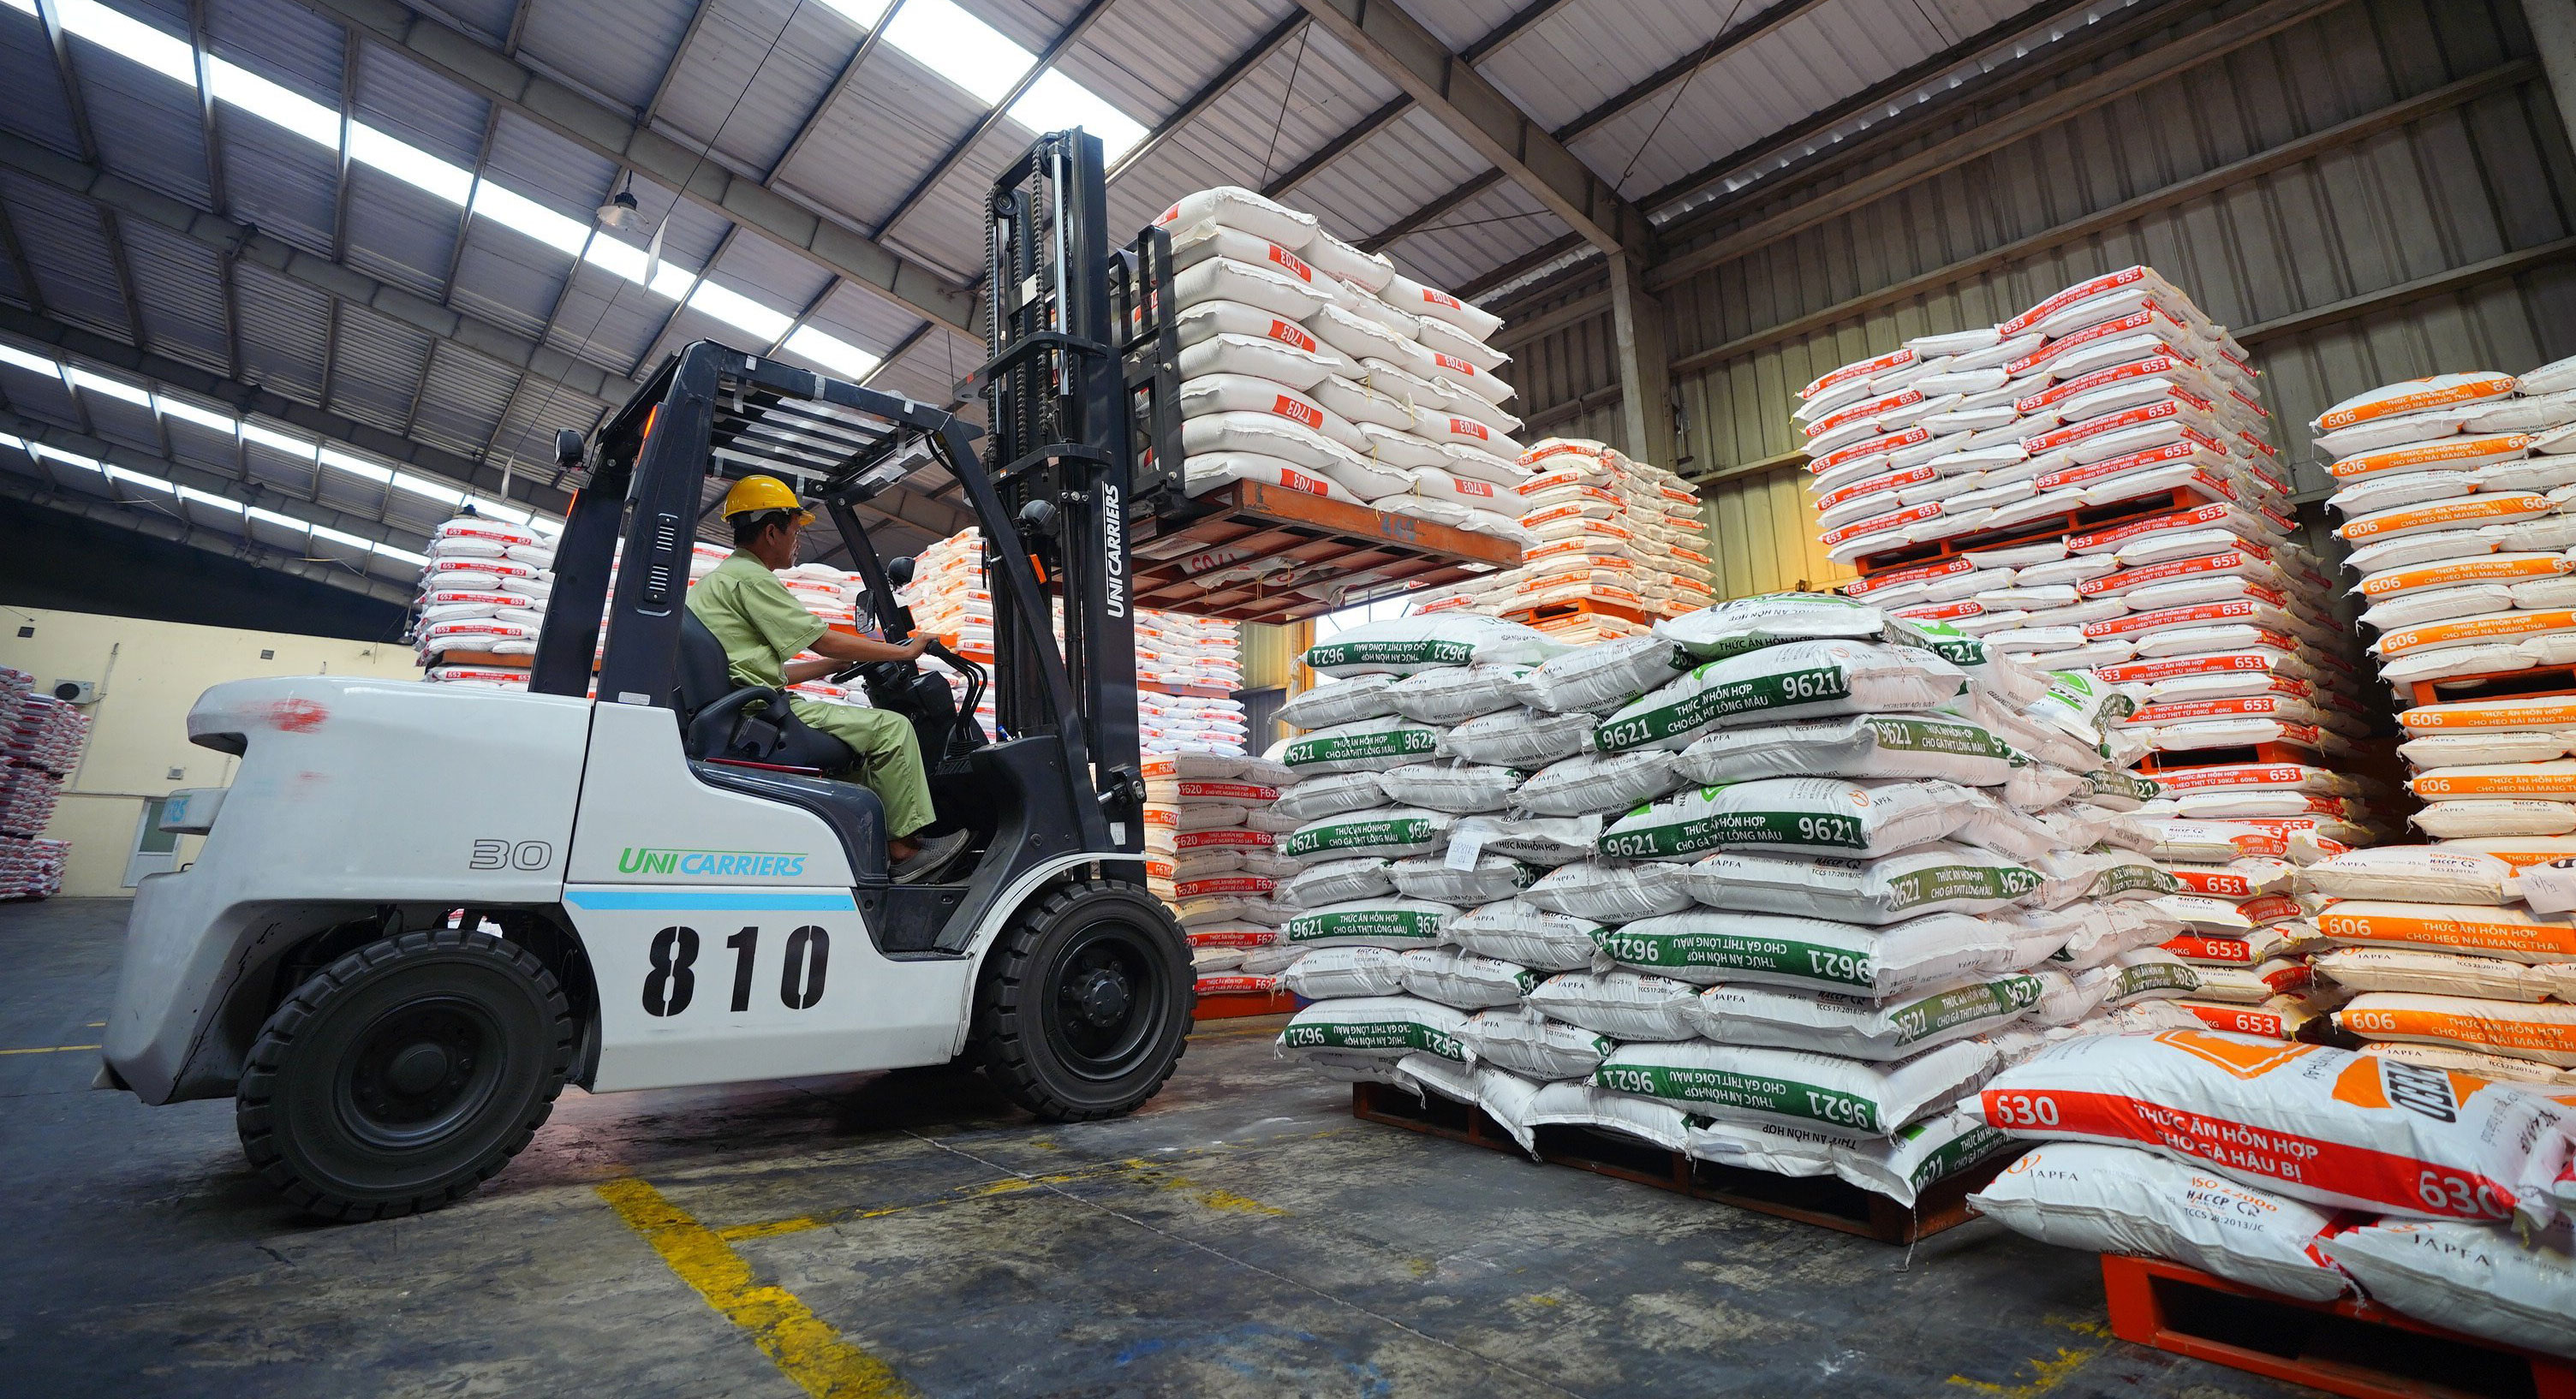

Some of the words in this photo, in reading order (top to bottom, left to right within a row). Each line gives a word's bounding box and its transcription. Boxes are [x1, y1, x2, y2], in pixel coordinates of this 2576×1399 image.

[1280, 250, 1302, 275] T703
[2116, 269, 2139, 284] 653
[1432, 291, 1452, 307] T703
[2003, 318, 2025, 334] 653
[2126, 313, 2150, 327] 653
[1445, 356, 1465, 372] T703
[1892, 352, 1910, 364] 653
[2142, 358, 2167, 372] 653
[2020, 396, 2043, 410] 653
[2148, 403, 2172, 418] 653
[1286, 401, 1311, 423] T703
[2328, 410, 2357, 426] 606
[1459, 420, 1480, 437] T703
[2164, 445, 2190, 458] 653
[2338, 460, 2367, 474] 606
[1463, 481, 1484, 495] T703
[1918, 504, 1938, 517] 653
[2347, 521, 2379, 537] 606
[517, 537, 532, 545] 652
[2070, 535, 2093, 549] 653
[1849, 583, 1869, 594] 653
[2369, 577, 2401, 593] 606
[1959, 602, 1978, 614] 653
[2222, 603, 2250, 615] 653
[2087, 623, 2112, 635] 653
[2387, 633, 2418, 650] 606
[1313, 647, 1345, 664] 9621
[1434, 643, 1467, 661] 9621
[2234, 658, 2263, 669] 653
[1732, 683, 1753, 697] HỢP
[1783, 670, 1841, 700] 9621
[2243, 699, 2269, 711] 653
[1667, 719, 1688, 733] CHO
[1716, 698, 1744, 716] LÔNG
[1745, 694, 1769, 710] MÀU
[2409, 714, 2443, 726] 606
[1603, 718, 1651, 749] 9621
[1182, 784, 1202, 794] F620
[2420, 779, 2451, 792] 606
[1684, 820, 1708, 835] THỨC
[1744, 816, 1766, 828] HỢP
[1798, 817, 1858, 845] 9621
[1607, 833, 1659, 857] 9621
[1676, 839, 1696, 852] CHO
[1727, 830, 1756, 842] LÔNG
[1757, 830, 1782, 842] MÀU
[469, 839, 552, 871] 30
[2207, 877, 2242, 893] 653
[1340, 914, 1357, 923] THỨC
[1385, 914, 1398, 924] HỢP
[2329, 917, 2371, 936] 606
[1292, 918, 1323, 938] 9621
[1357, 926, 1372, 934] THỊT
[1373, 925, 1392, 933] LÔNG
[1393, 925, 1407, 934] MÀU
[2422, 921, 2457, 933] THỨC
[2459, 923, 2478, 934] ĂN
[2479, 923, 2509, 938] HỖN
[2511, 927, 2538, 942] HỢP
[1609, 938, 1659, 962] 9621
[1673, 938, 1696, 951] MÀU
[1696, 937, 1722, 952] LÔNG
[1722, 938, 1745, 951] THỊT
[1746, 940, 1761, 953] GÀ
[1765, 943, 1787, 954] CHO
[2206, 941, 2243, 957] 653
[2406, 932, 2431, 942] CHO
[2434, 934, 2460, 945] HEO
[2462, 934, 2485, 947] NÁI
[2487, 938, 2525, 950] MANG
[2528, 940, 2560, 952] THAI
[1687, 950, 1706, 963] HỢP
[1707, 951, 1728, 965] HỖN
[1730, 953, 1745, 966] ĂN
[1747, 955, 1777, 968] THỨC
[642, 926, 830, 1016] 810
[1807, 950, 1872, 983] 9621
[2236, 1015, 2275, 1034] 653
[2352, 1012, 2396, 1031] 606
[1291, 1027, 1326, 1046] 9621
[2387, 1049, 2422, 1057] JAPFA
[1603, 1070, 1655, 1093] 9621
[1670, 1071, 1692, 1084] MÀU
[1762, 1081, 1786, 1095] CHO
[1806, 1090, 1869, 1129] 9621
[1997, 1095, 2060, 1126] 630
[2133, 1102, 2188, 1130] THỨC
[2191, 1118, 2219, 1139] ĂN
[2223, 1122, 2269, 1150] HỖN
[2274, 1140, 2319, 1161] HỢP
[2156, 1130, 2196, 1153] CHO
[2199, 1140, 2228, 1163] GÀ
[2231, 1149, 2276, 1173] HẬU
[2281, 1159, 2303, 1184] BỊ
[2029, 1169, 2079, 1182] JAPFA
[2191, 1176, 2219, 1190] ISO
[2186, 1189, 2230, 1206] HACCP
[2418, 1170, 2512, 1219] 630
[2184, 1208, 2208, 1219] TCCS
[2414, 1233, 2491, 1266] JAPFA
